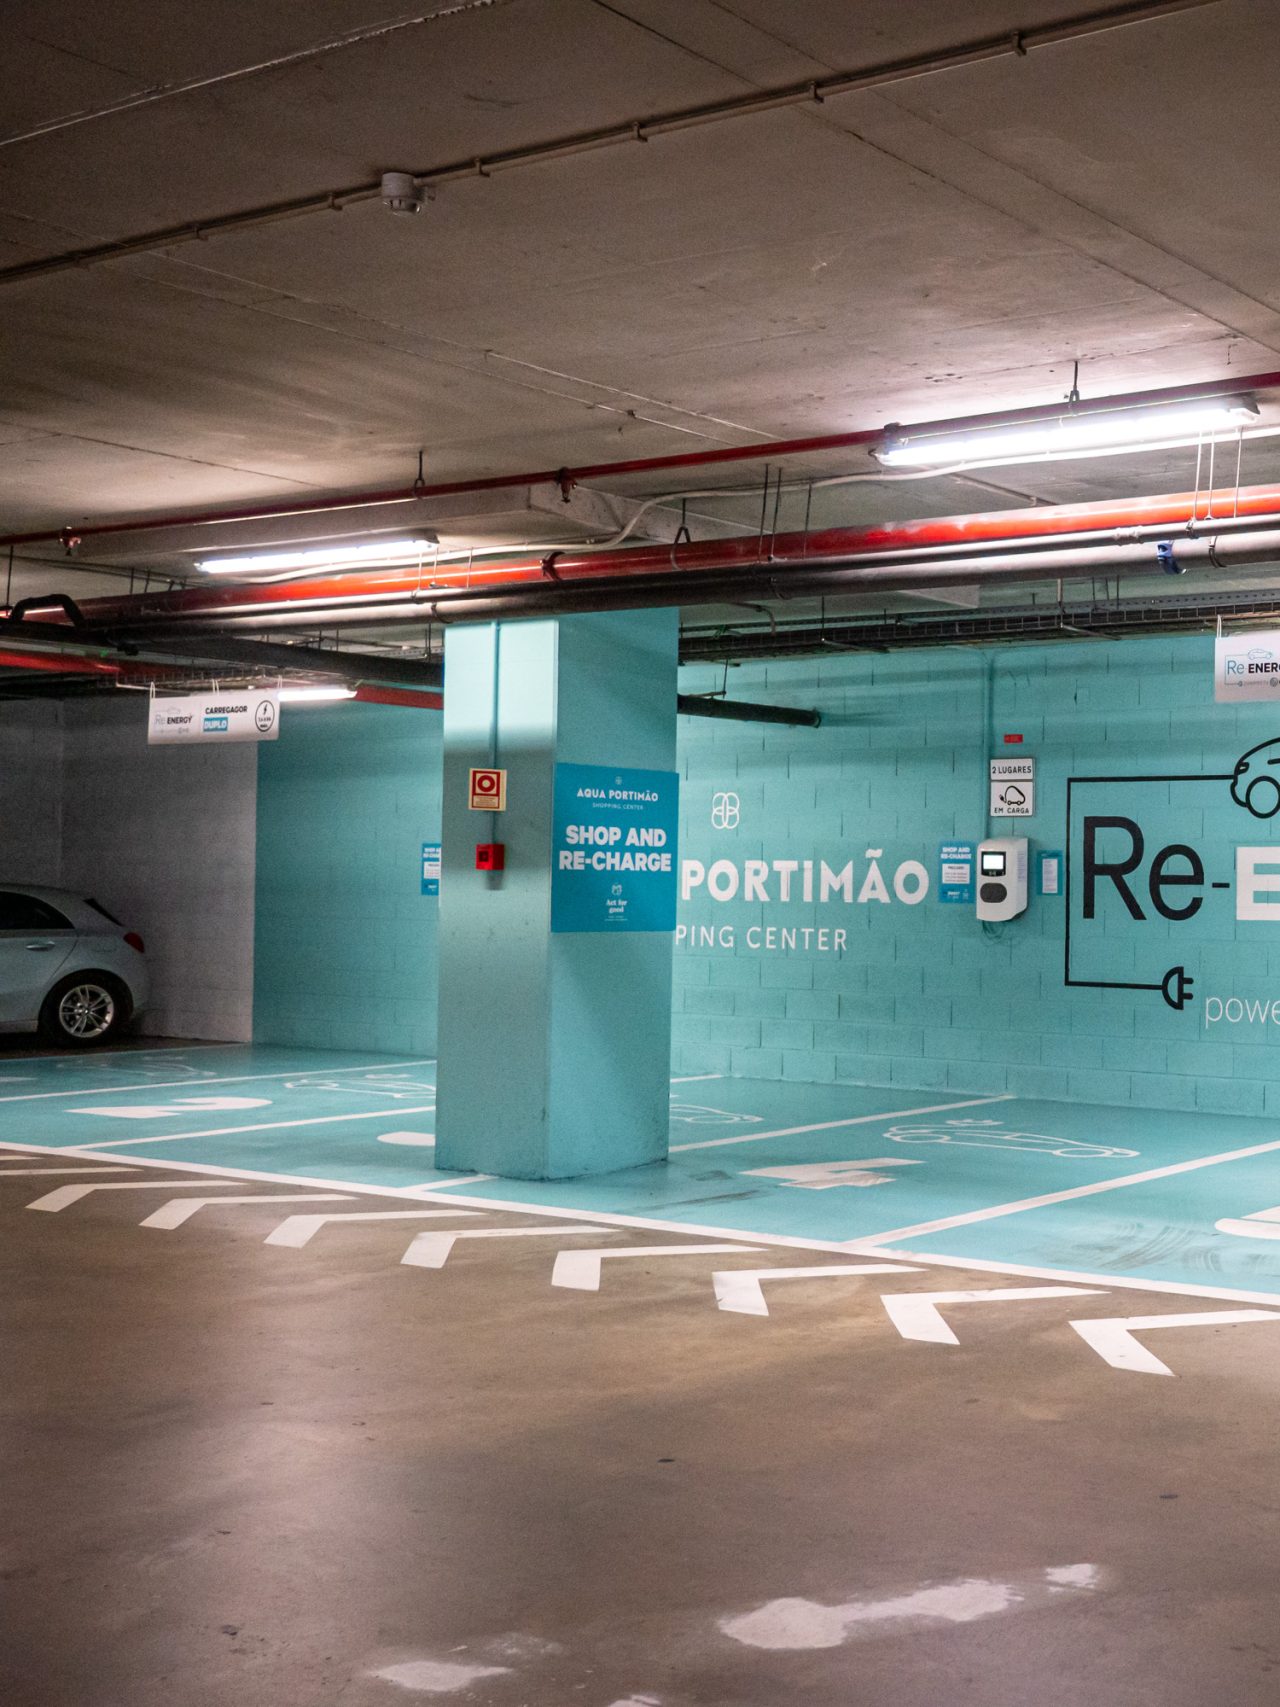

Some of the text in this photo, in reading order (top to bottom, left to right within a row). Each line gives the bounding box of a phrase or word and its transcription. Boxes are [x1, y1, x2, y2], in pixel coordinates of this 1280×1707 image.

[205, 705, 248, 715] CARREGAGOR
[167, 714, 193, 725] ENERGY
[204, 720, 228, 730] DUPLO
[992, 765, 1032, 774] 2 LUGARES
[577, 788, 659, 802] AQUA PORTIMÃO
[592, 802, 644, 811] SHOPPING CENTER
[565, 825, 667, 847] SHOP AND
[559, 850, 672, 872] RE-CHARGE
[681, 848, 929, 905] PORTIMÃO
[746, 926, 847, 951] CENTER
[738, 1157, 926, 1190] 4
